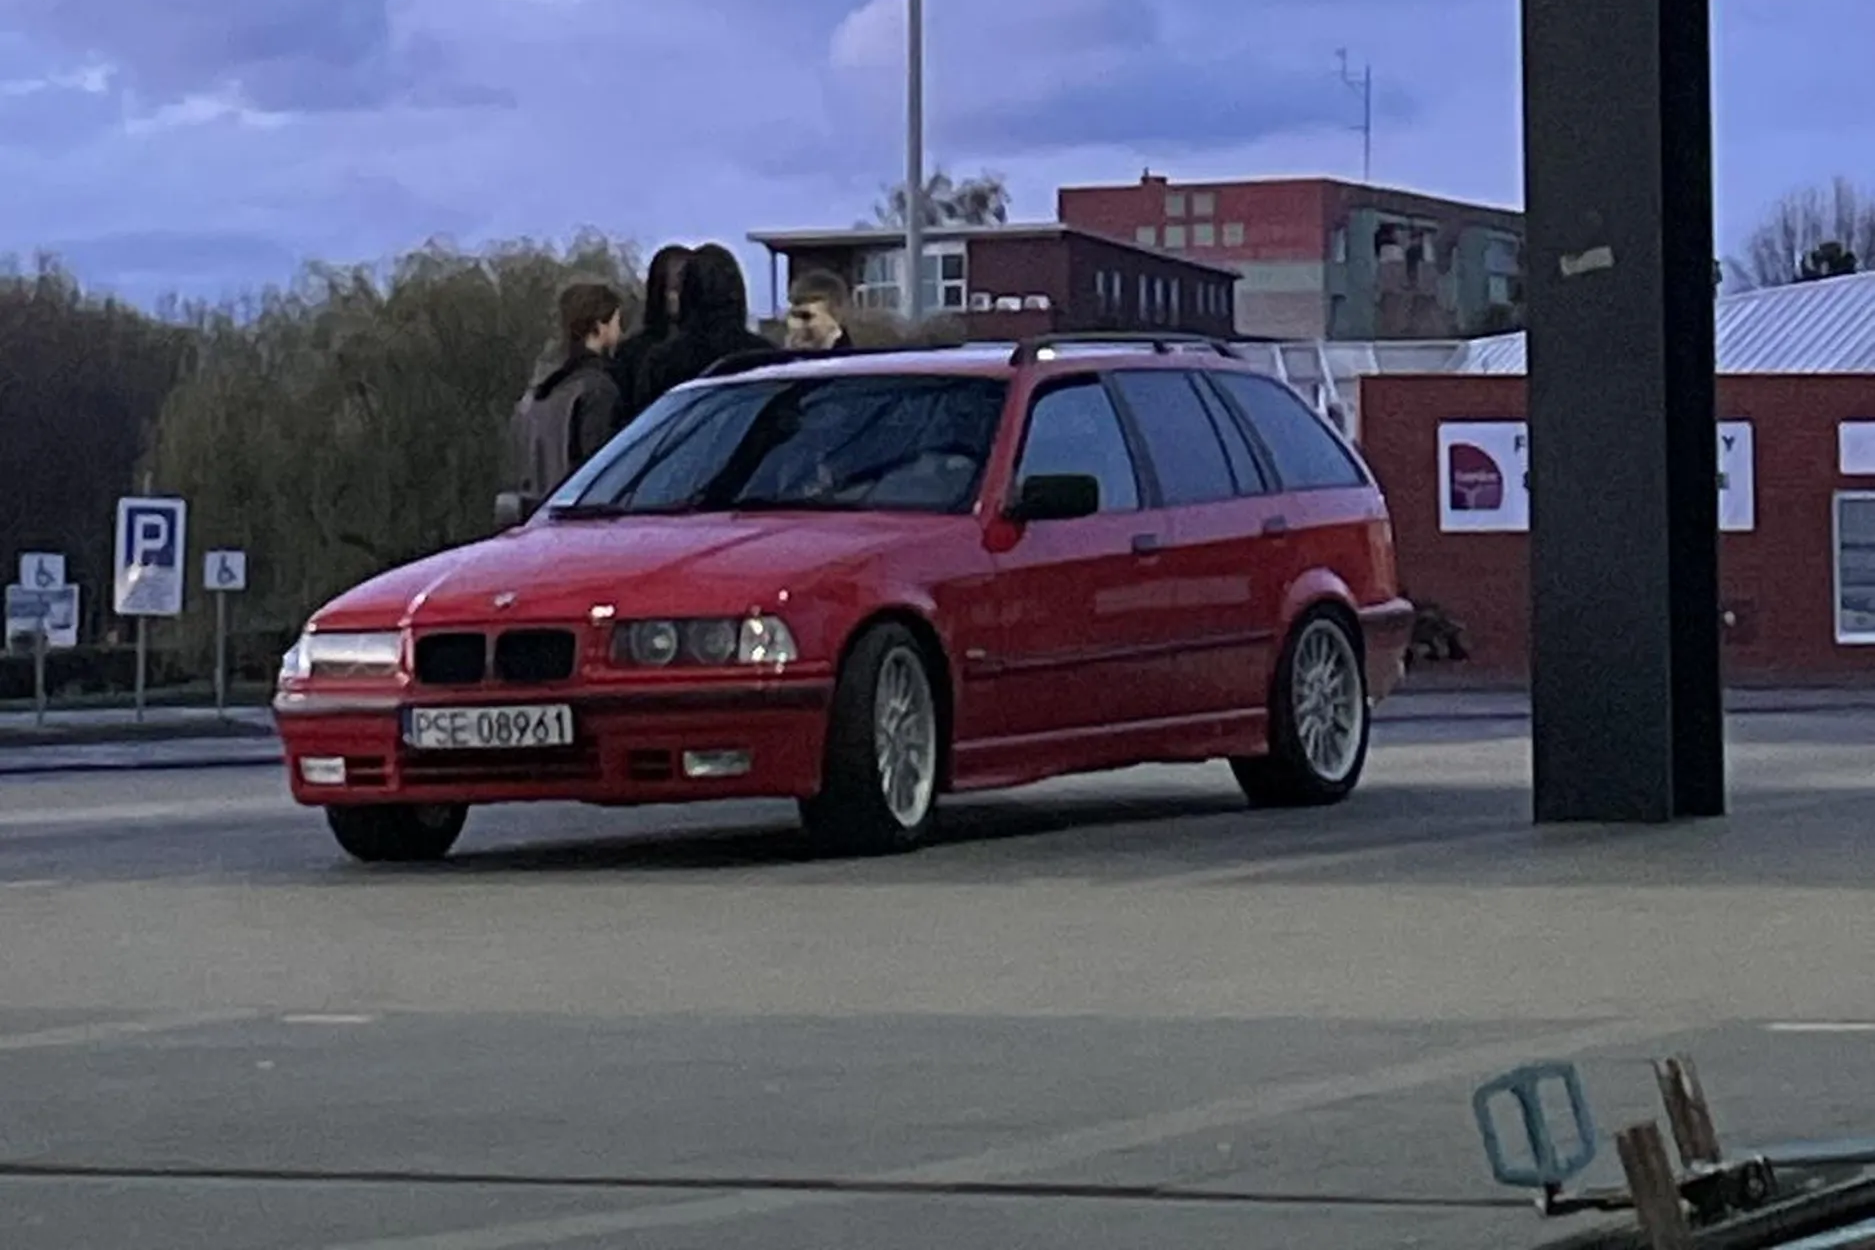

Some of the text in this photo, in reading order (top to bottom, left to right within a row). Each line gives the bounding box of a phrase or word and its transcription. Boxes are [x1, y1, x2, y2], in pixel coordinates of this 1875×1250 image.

[133, 514, 168, 566] P
[416, 709, 566, 745] PSE 08961
